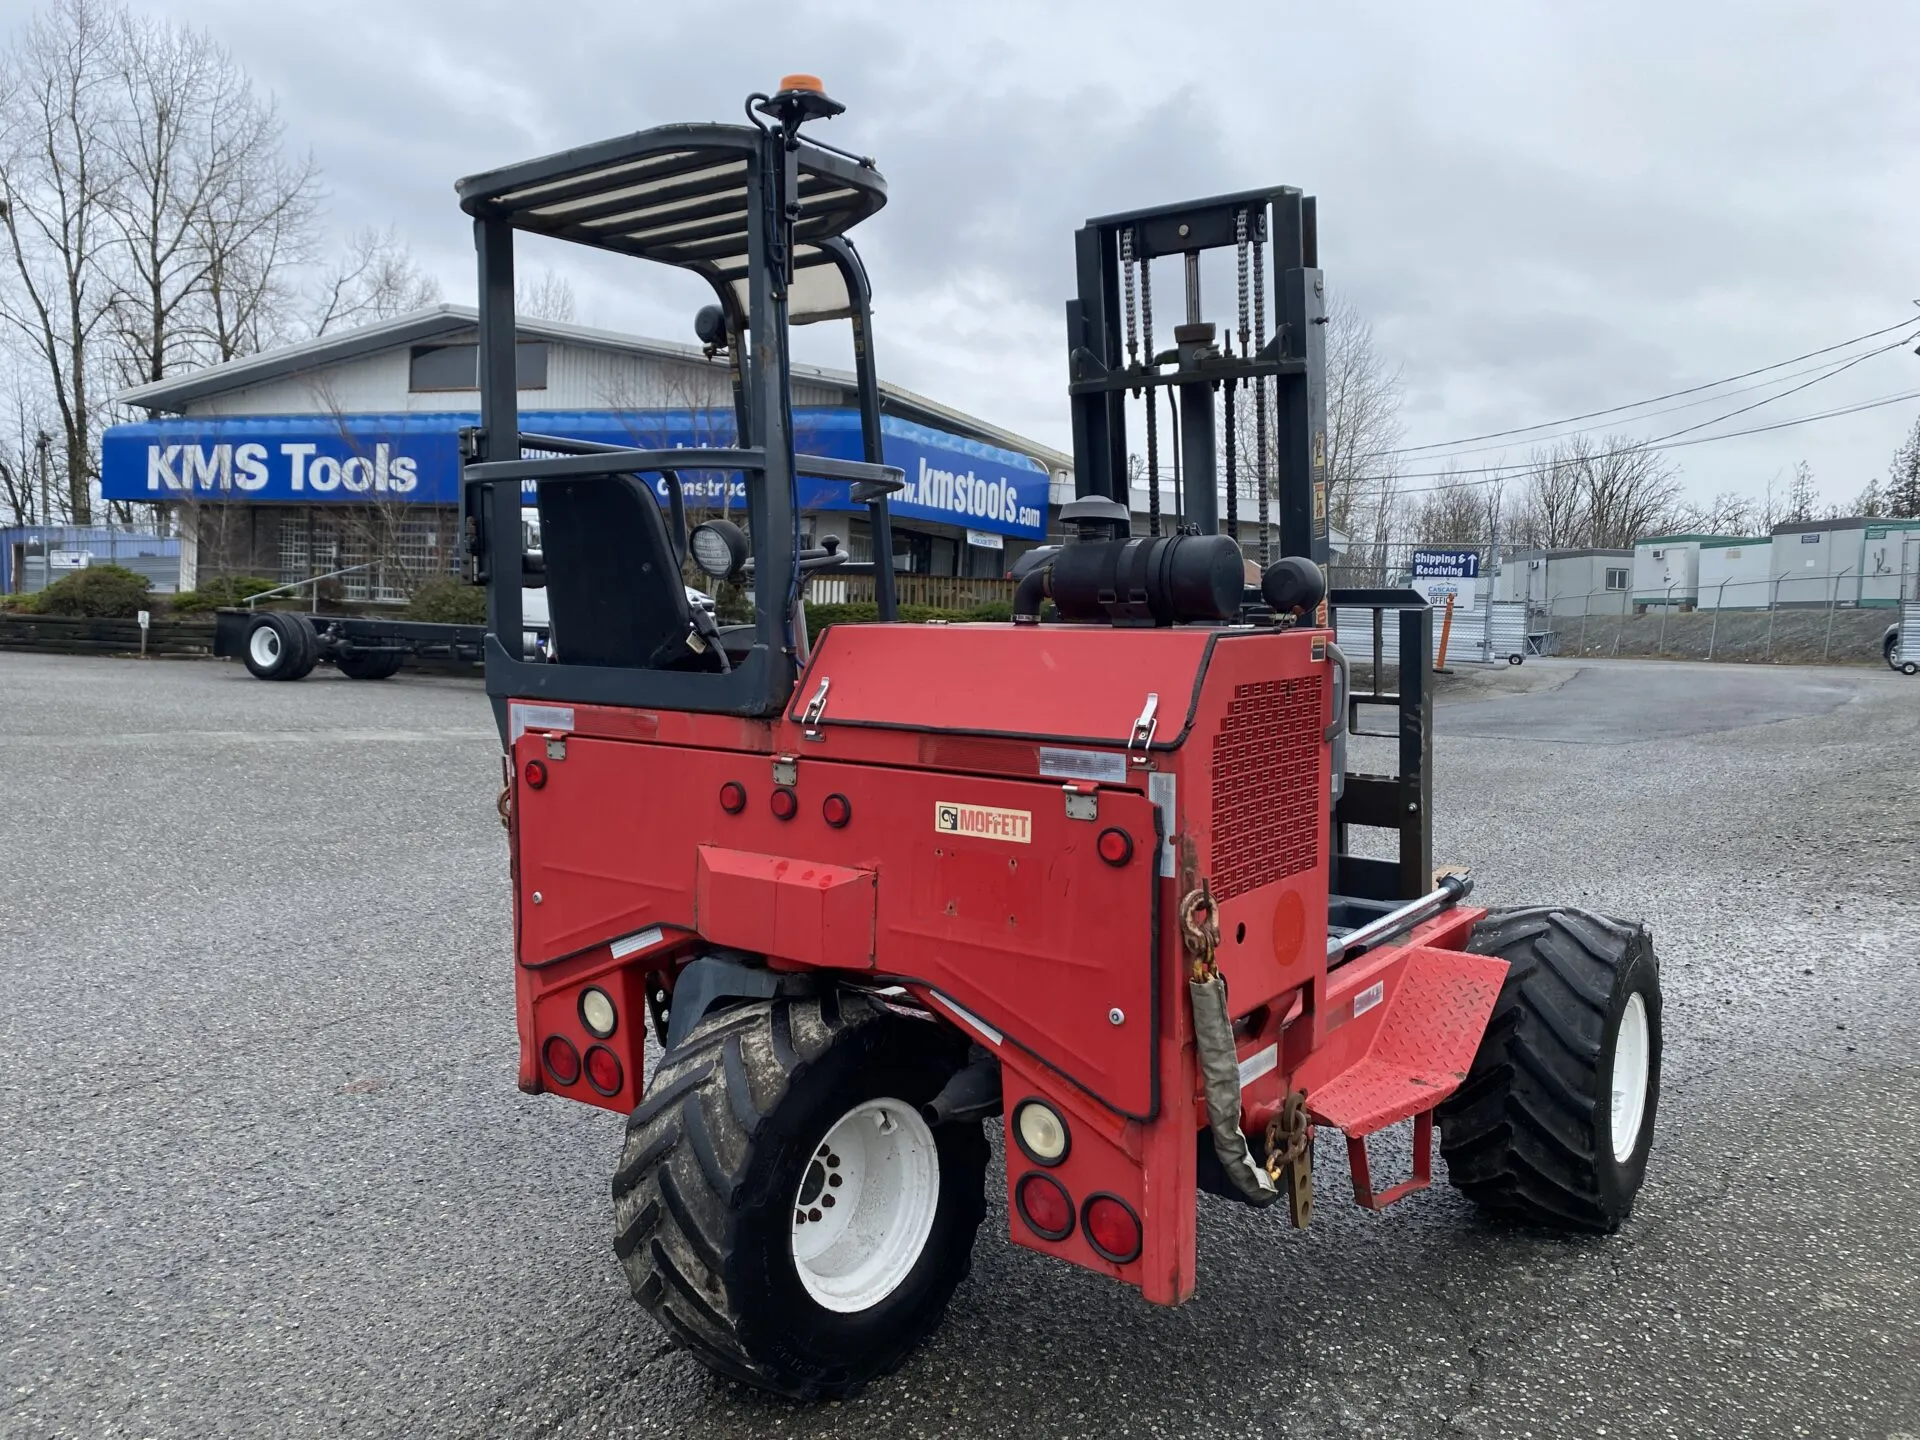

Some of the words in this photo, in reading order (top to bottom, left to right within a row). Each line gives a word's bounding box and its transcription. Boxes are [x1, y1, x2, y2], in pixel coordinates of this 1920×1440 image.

[148, 443, 269, 490] KMS
[281, 443, 417, 491] Tools
[1415, 553, 1456, 565] Shipping
[1458, 554, 1466, 563] &
[1416, 565, 1463, 576] Receiving
[960, 809, 1028, 838] MOFFETT
